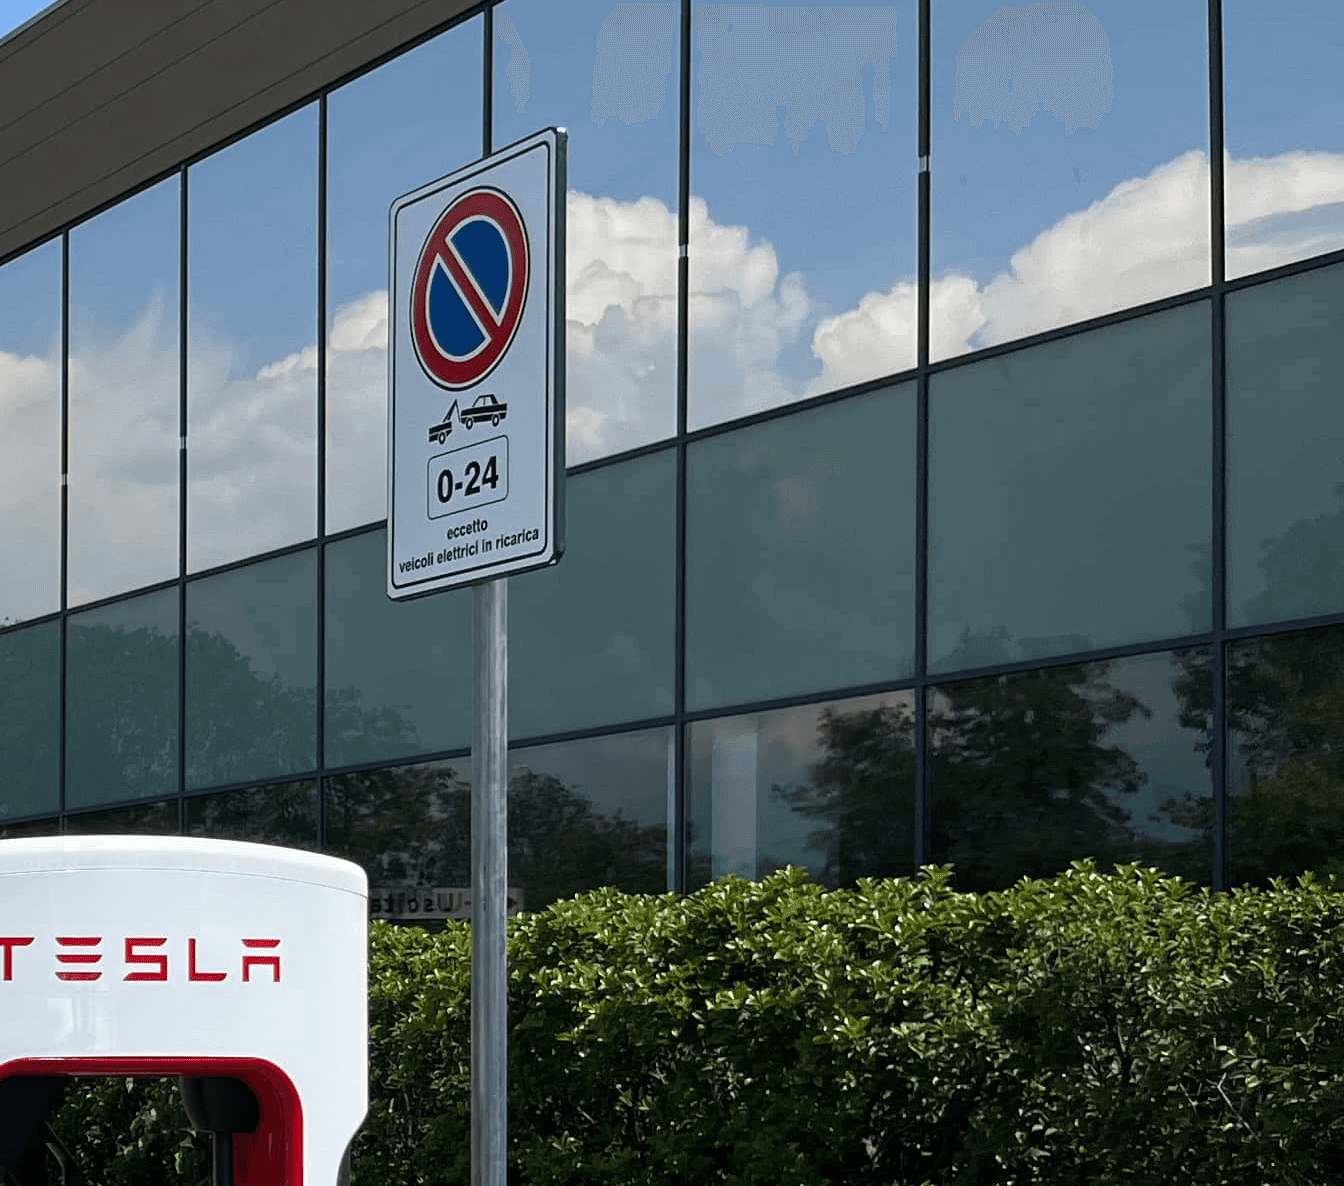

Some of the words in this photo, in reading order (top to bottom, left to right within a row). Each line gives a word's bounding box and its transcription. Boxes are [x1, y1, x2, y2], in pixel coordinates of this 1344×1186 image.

[436, 455, 500, 504] 0-24
[398, 551, 434, 573] veicoli
[436, 539, 479, 564] elettrici
[481, 538, 493, 553] in
[495, 528, 540, 550] ricarica
[446, 518, 489, 540] eccetto
